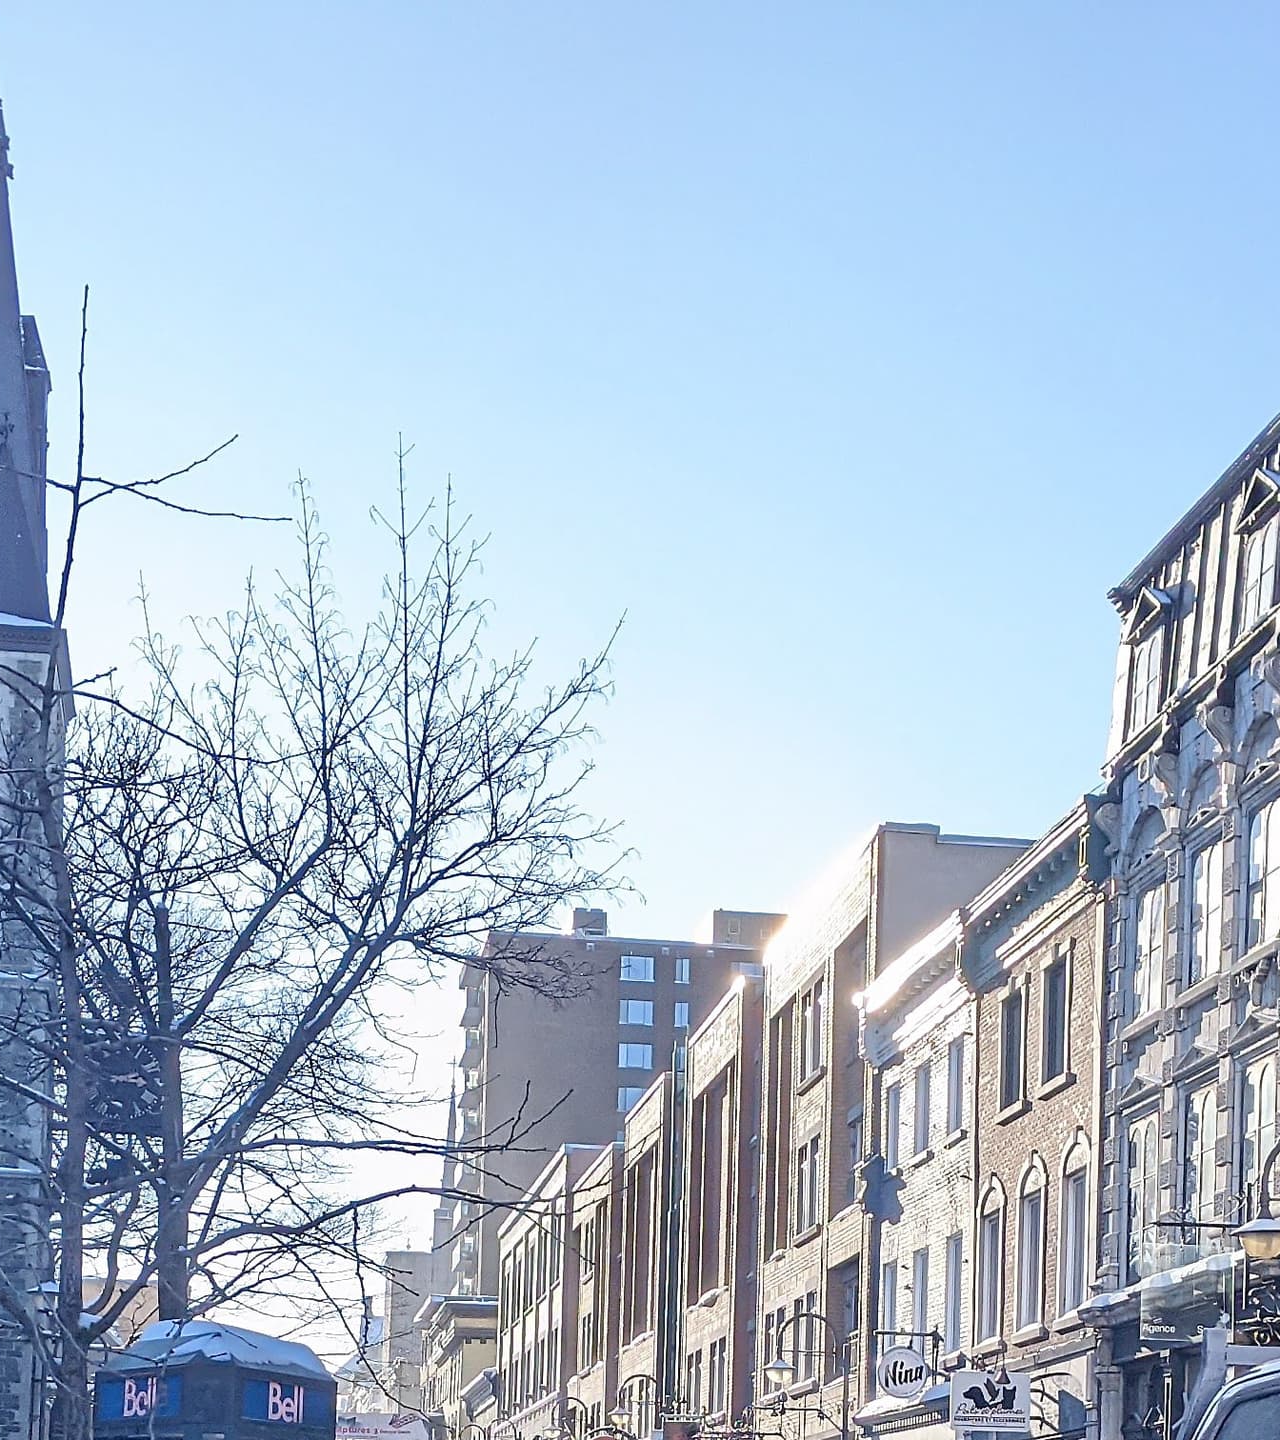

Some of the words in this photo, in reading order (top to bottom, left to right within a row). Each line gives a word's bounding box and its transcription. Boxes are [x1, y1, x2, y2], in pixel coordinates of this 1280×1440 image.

[1142, 1323, 1176, 1334] Agence
[884, 1360, 925, 1389] Nina
[268, 1381, 305, 1424] Bell
